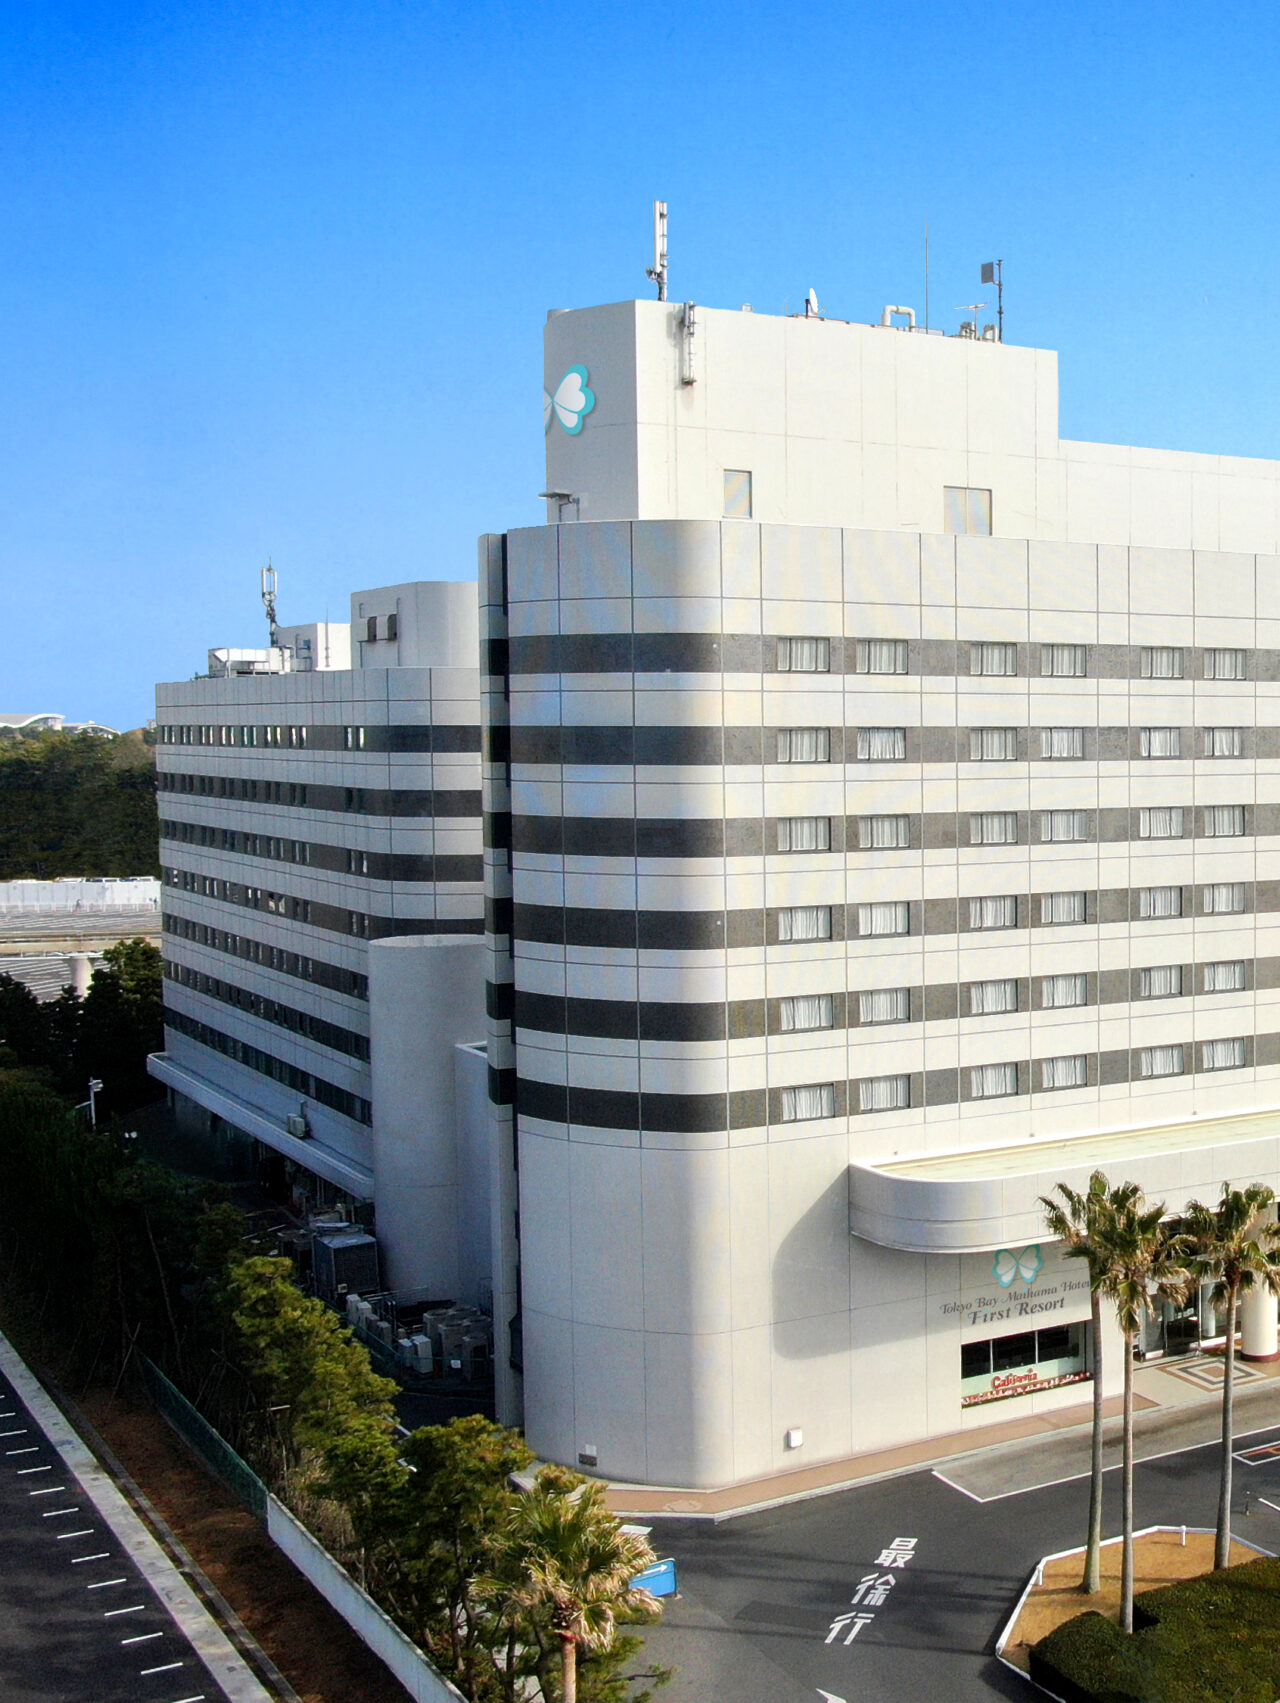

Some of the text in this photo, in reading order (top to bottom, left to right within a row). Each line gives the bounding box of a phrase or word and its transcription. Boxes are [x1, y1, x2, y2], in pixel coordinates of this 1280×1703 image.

[939, 1280, 1090, 1314] Tokyo Bay Maihama Hotel
[968, 1297, 1065, 1325] First Resort
[992, 1368, 1038, 1389] California
[824, 1537, 918, 1646] 最徐行
